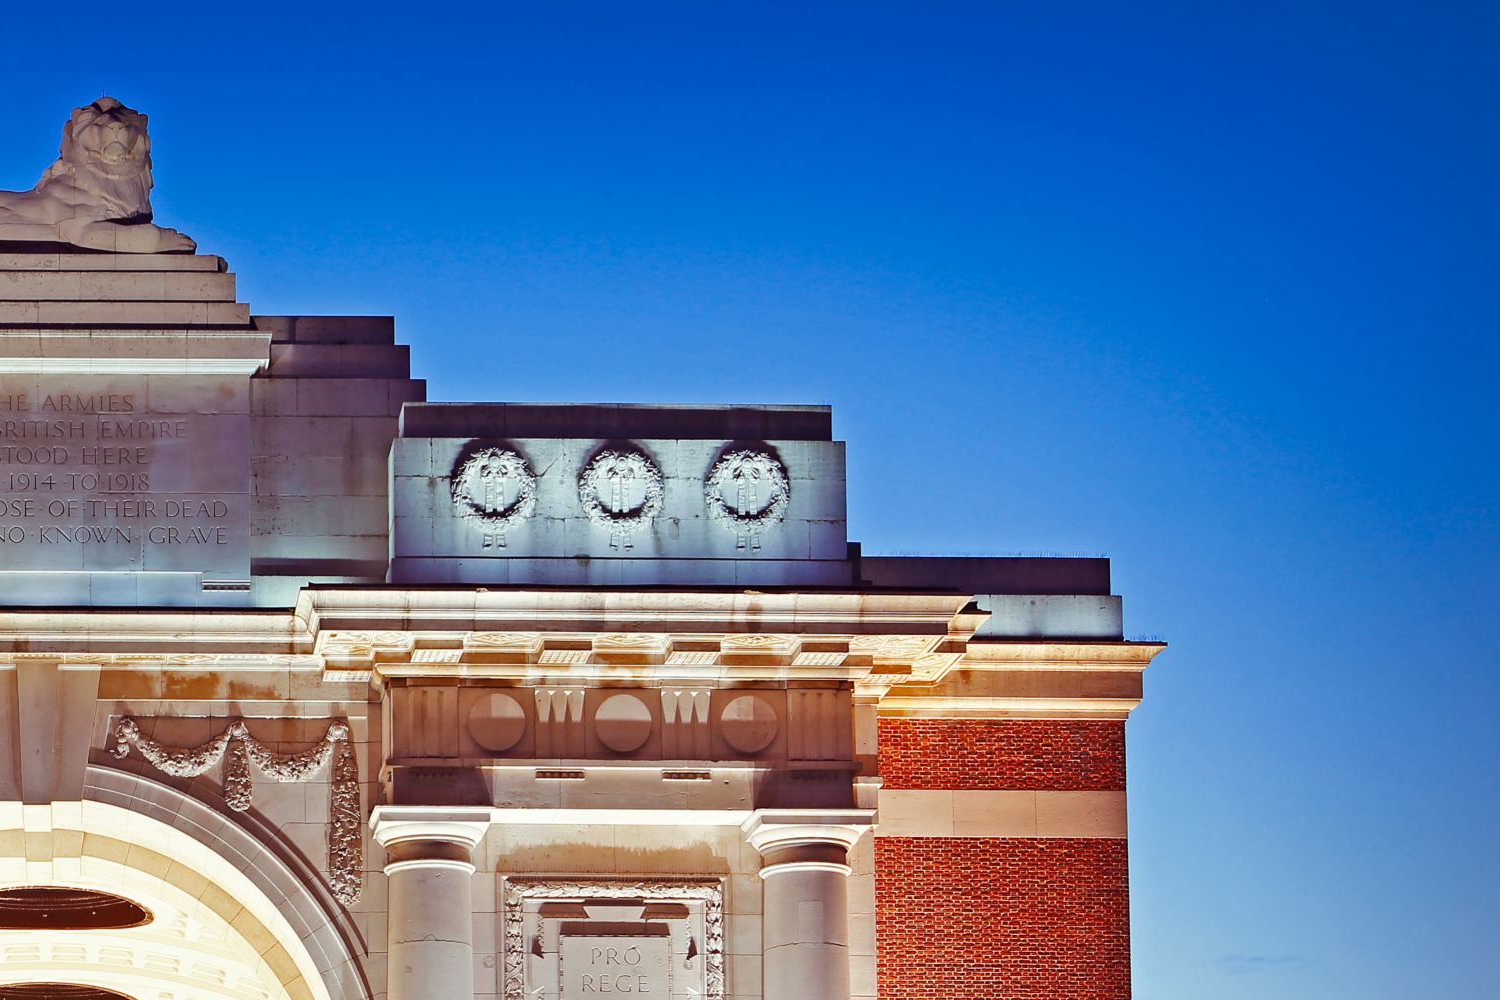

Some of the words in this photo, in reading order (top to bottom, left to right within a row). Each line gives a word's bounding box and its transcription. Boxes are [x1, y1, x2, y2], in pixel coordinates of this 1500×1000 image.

[42, 394, 135, 412] ARMIES
[101, 421, 187, 439] EMPIRE
[82, 447, 148, 465] HERE
[9, 473, 56, 491] 1914
[67, 473, 98, 491] TO
[108, 473, 150, 491] 1918
[48, 500, 78, 517] OF
[86, 500, 157, 518] THEIR
[166, 500, 229, 518] DEAD
[39, 526, 132, 544] KNOWN
[149, 526, 228, 545] GRAVE
[590, 946, 641, 965] PRO
[581, 975, 650, 993] REGE
